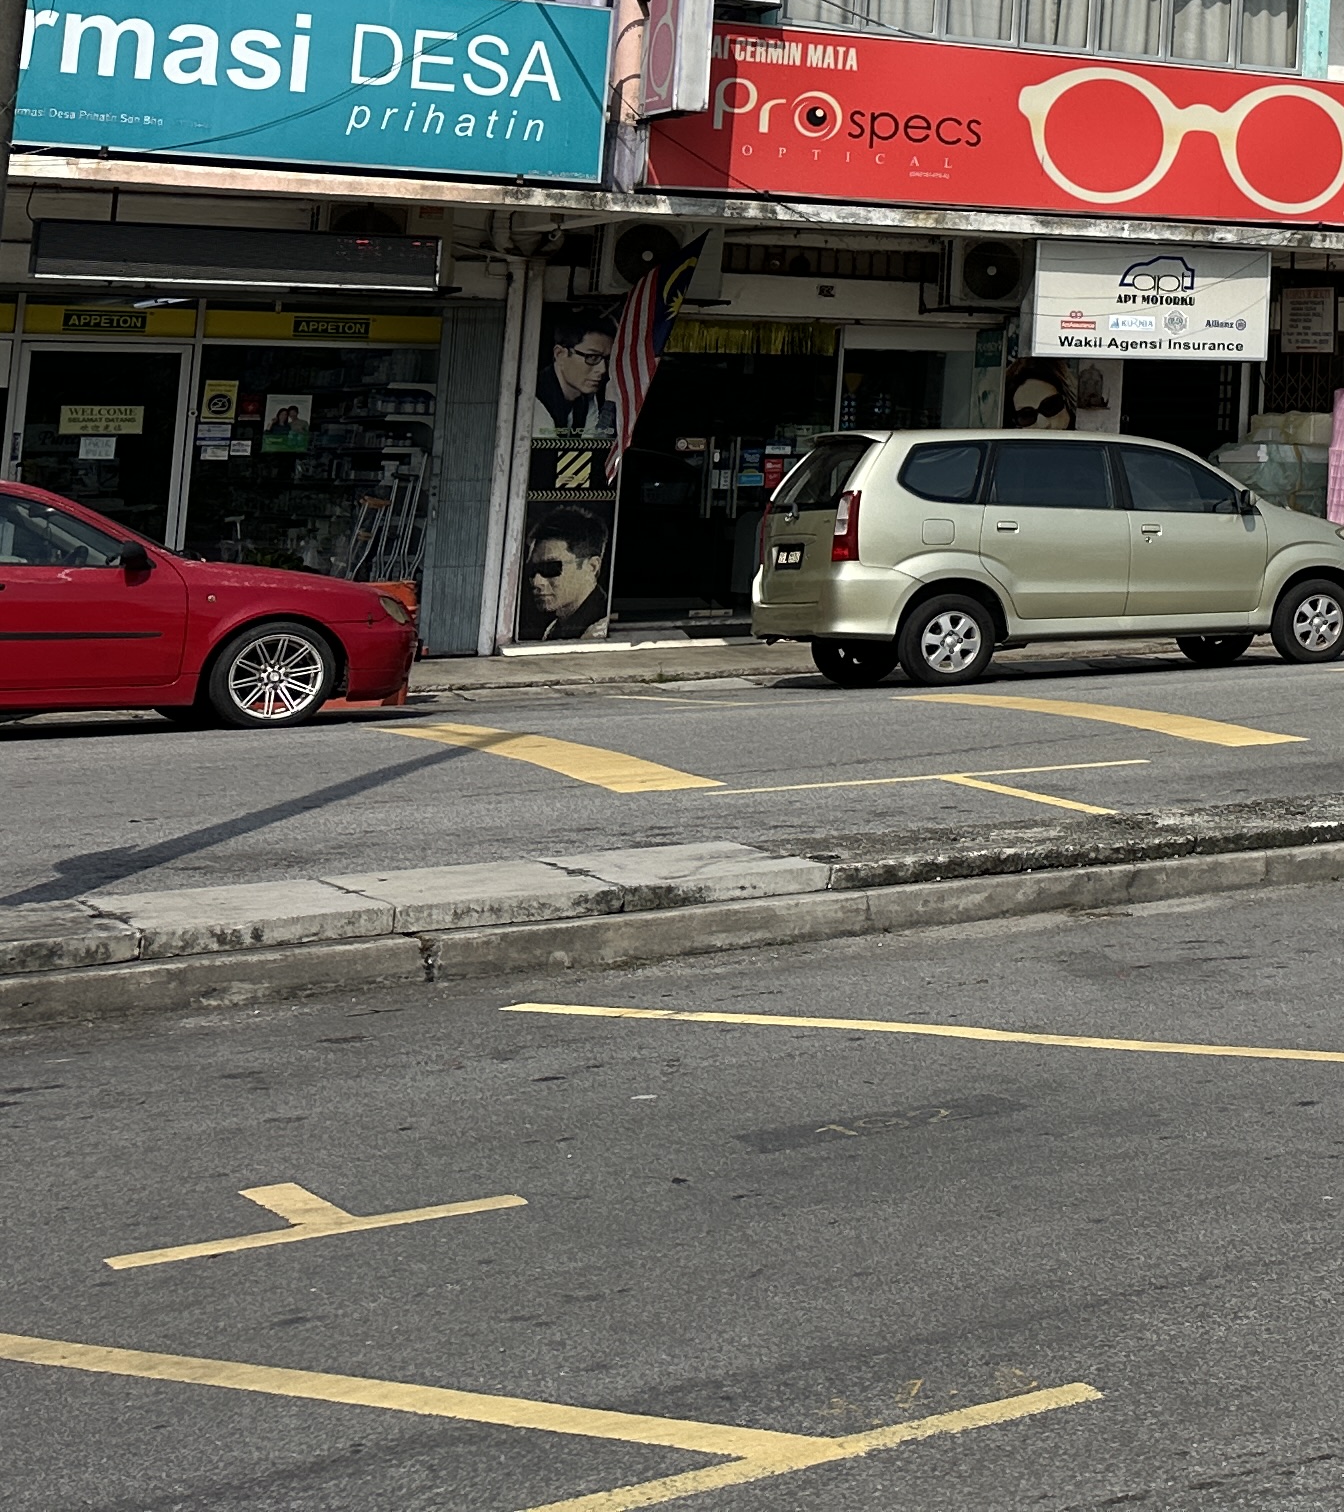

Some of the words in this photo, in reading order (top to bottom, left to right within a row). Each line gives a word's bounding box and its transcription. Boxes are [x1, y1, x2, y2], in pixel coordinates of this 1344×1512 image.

[19, 8, 312, 93] rmasi
[351, 23, 562, 101] DESA
[735, 37, 802, 66] CERMIN
[806, 44, 858, 71] MATA
[345, 101, 545, 142] prihatin
[742, 144, 953, 169] OPTICAL
[1132, 272, 1191, 296] apt
[1116, 294, 1137, 305] APT
[1141, 294, 1196, 306] MOTORKU
[69, 315, 142, 328] APPETON
[299, 322, 365, 334] APPETON
[1205, 319, 1235, 329] Allianz
[1058, 336, 1102, 349] Wakil
[1107, 337, 1162, 351] Agensi
[1168, 339, 1244, 352] Insurance
[69, 407, 138, 417] WELCOME
